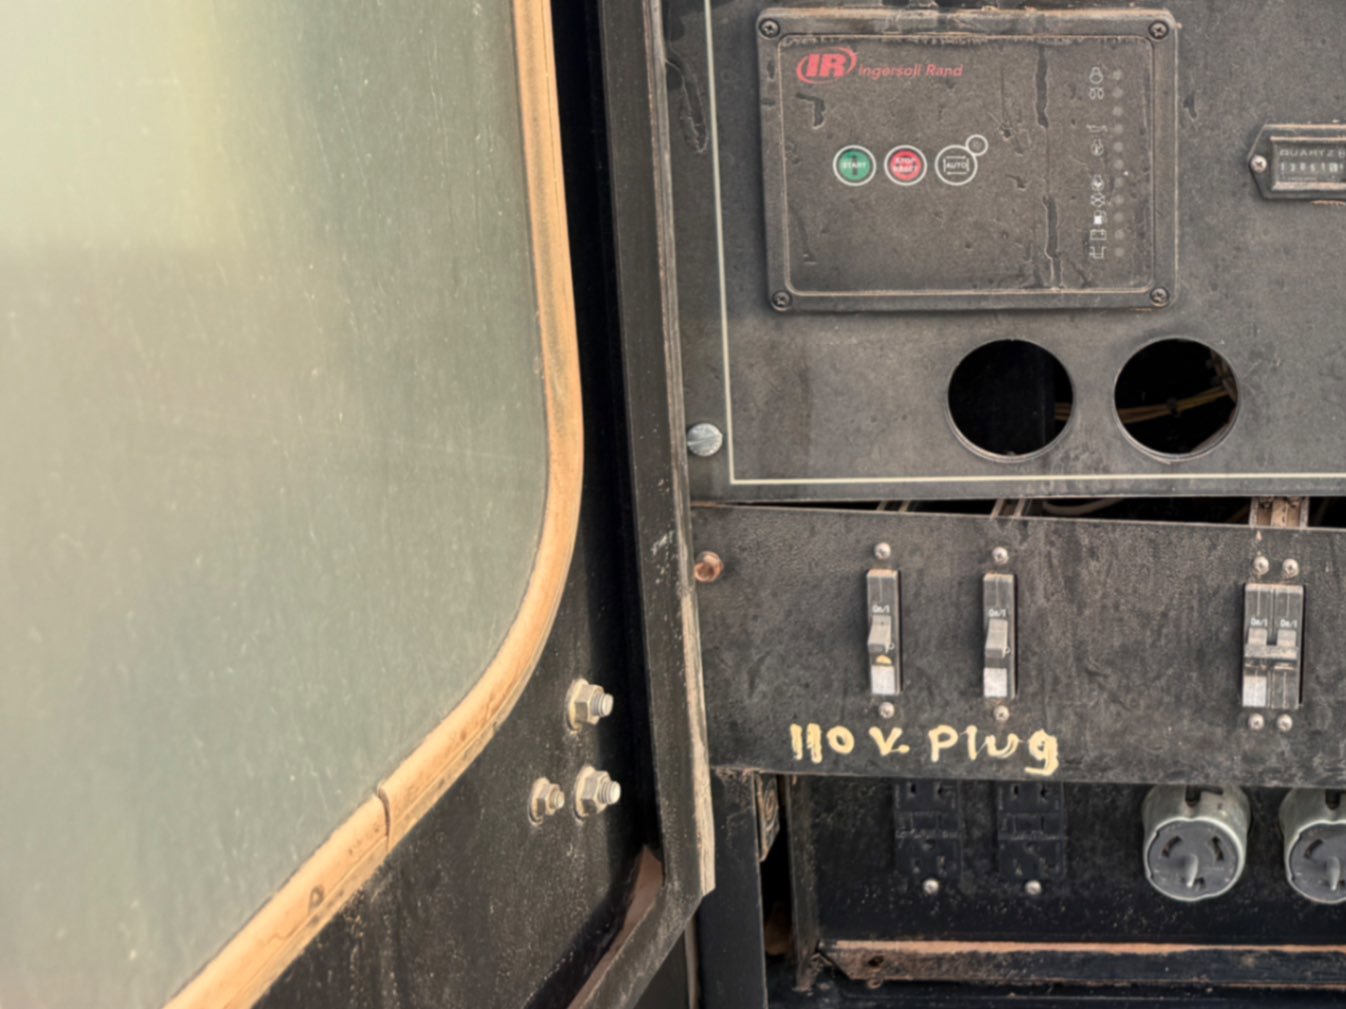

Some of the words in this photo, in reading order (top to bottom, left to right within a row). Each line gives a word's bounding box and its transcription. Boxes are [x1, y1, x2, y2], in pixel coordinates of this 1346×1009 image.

[859, 64, 921, 80] Ingersoll
[926, 64, 963, 77] Rand
[790, 723, 855, 764] 110
